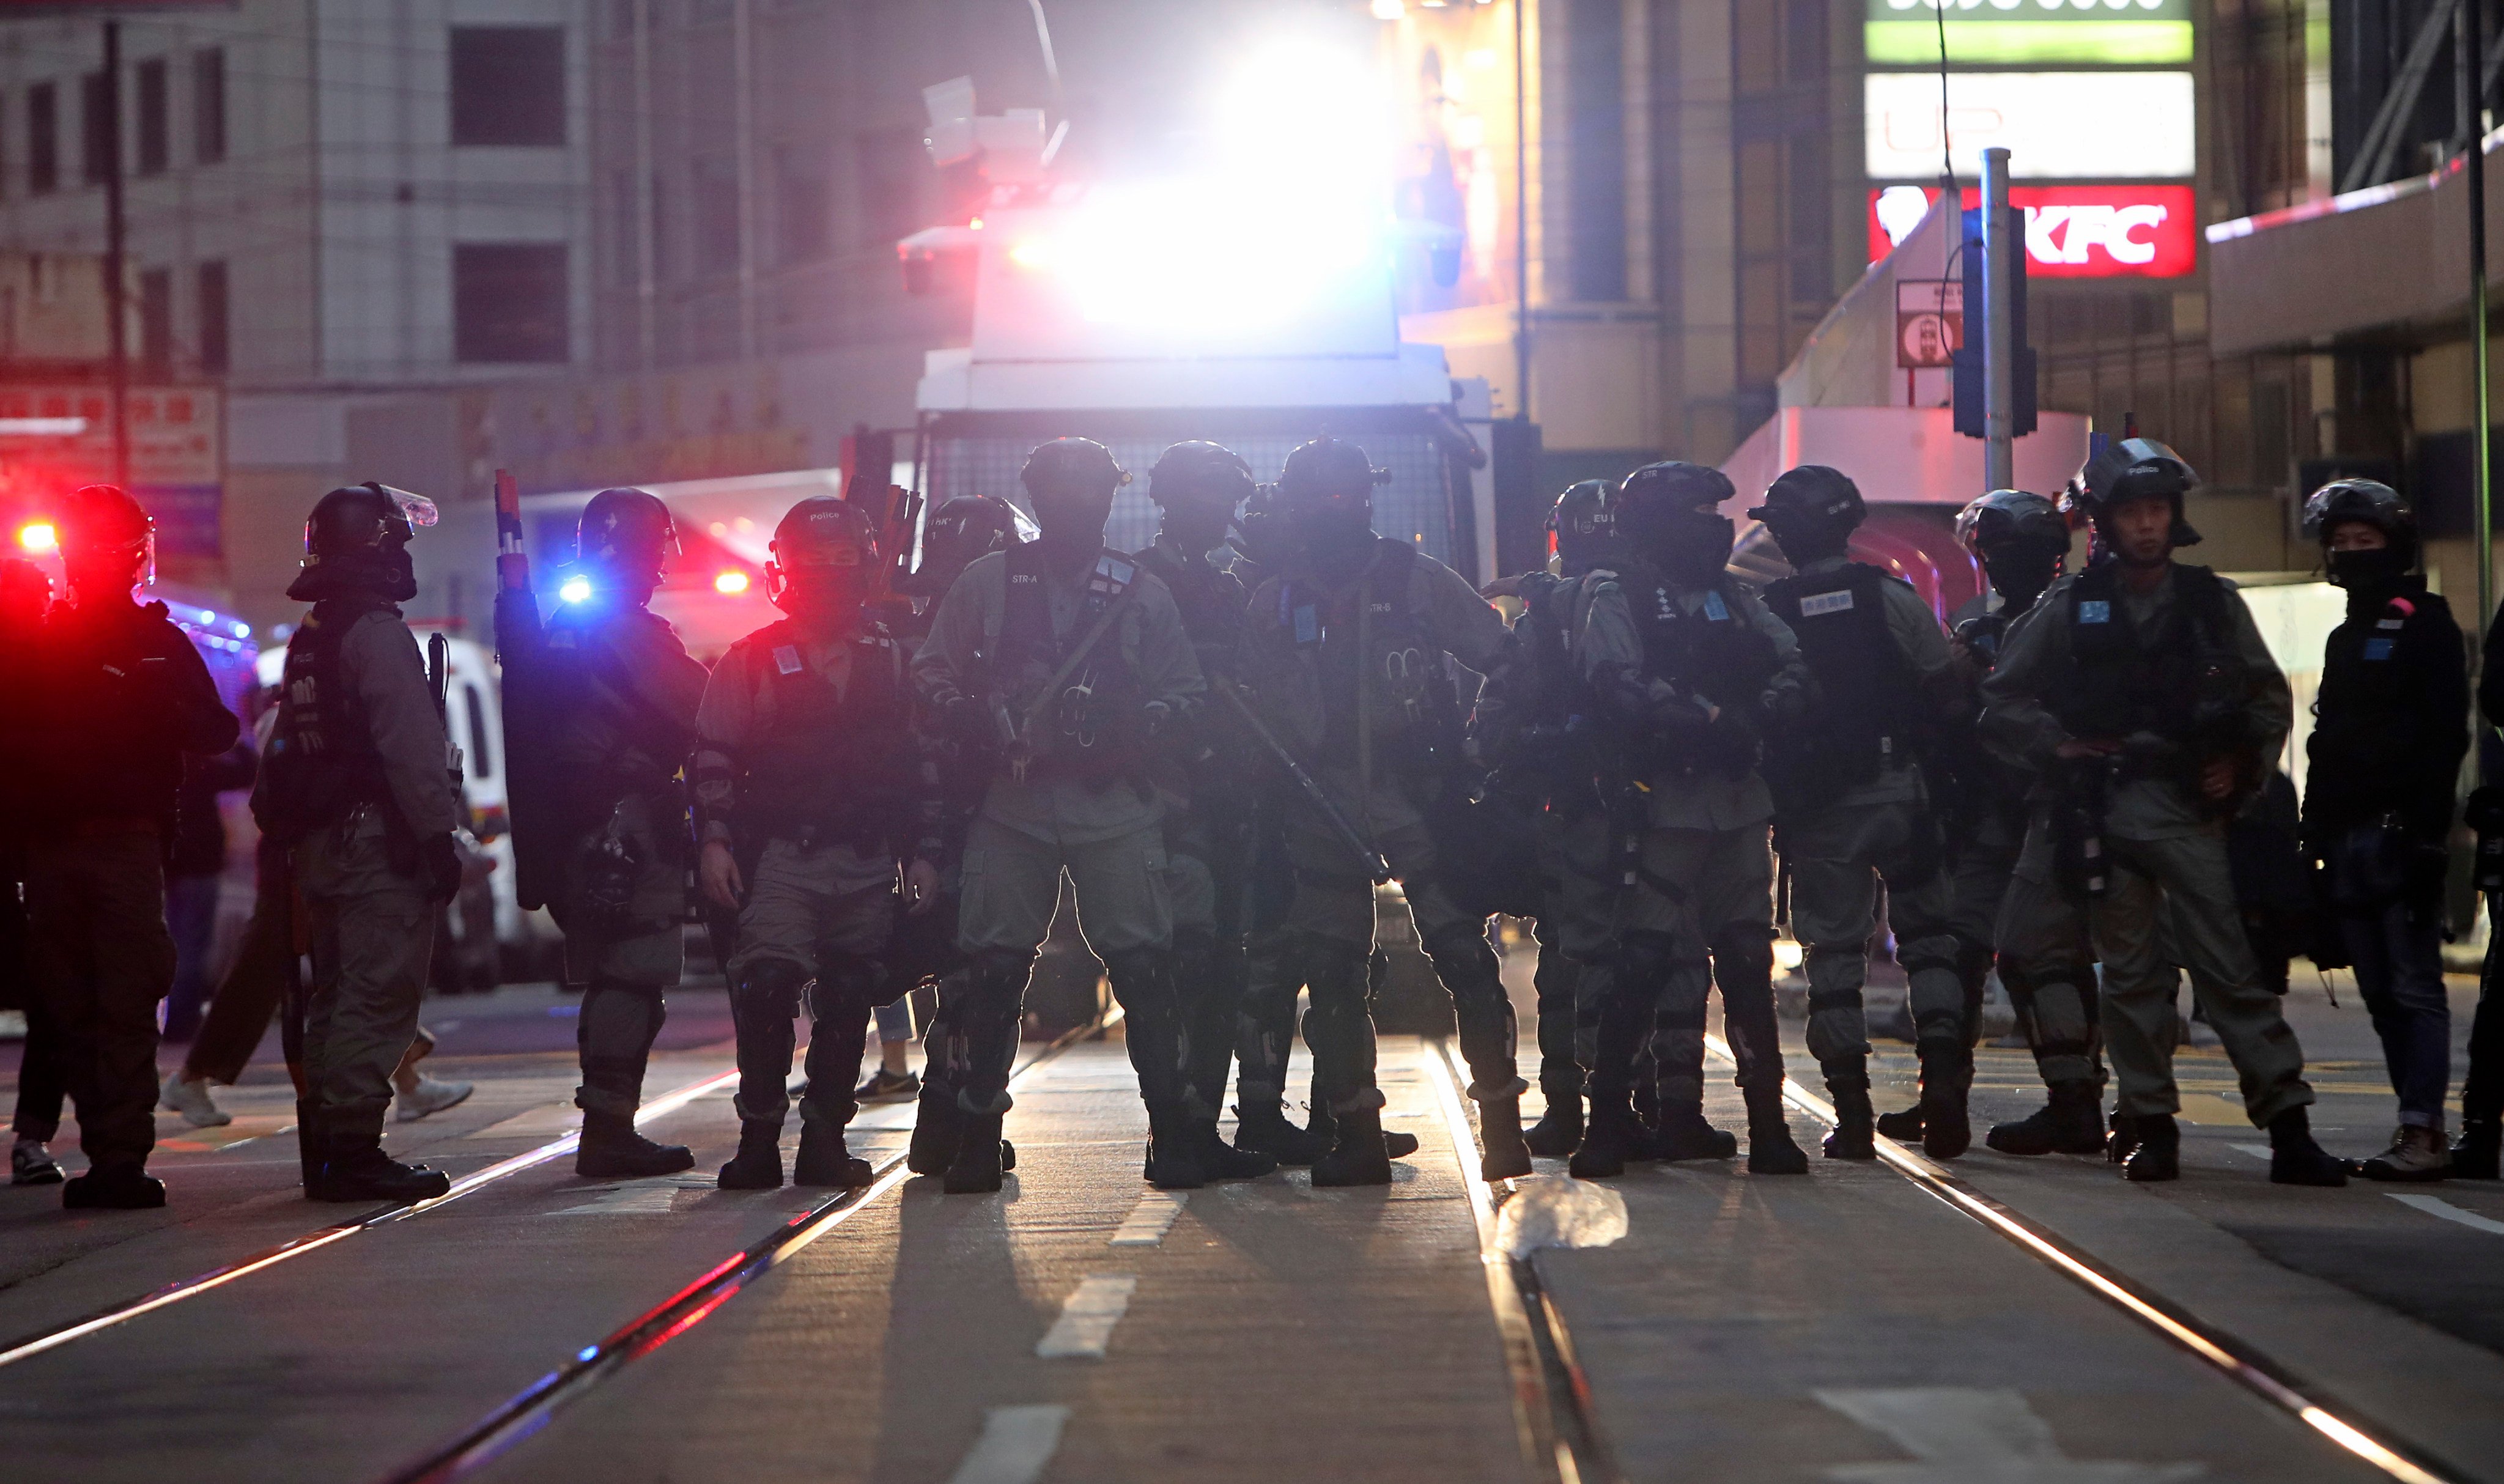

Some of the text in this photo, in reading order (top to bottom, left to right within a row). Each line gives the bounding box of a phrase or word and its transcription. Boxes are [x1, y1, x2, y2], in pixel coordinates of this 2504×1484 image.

[2024, 205, 2161, 264] KFC
[2129, 465, 2160, 476] Police
[810, 511, 840, 522] Police
[1594, 514, 1608, 523] EU
[1012, 574, 1038, 583] STR-A
